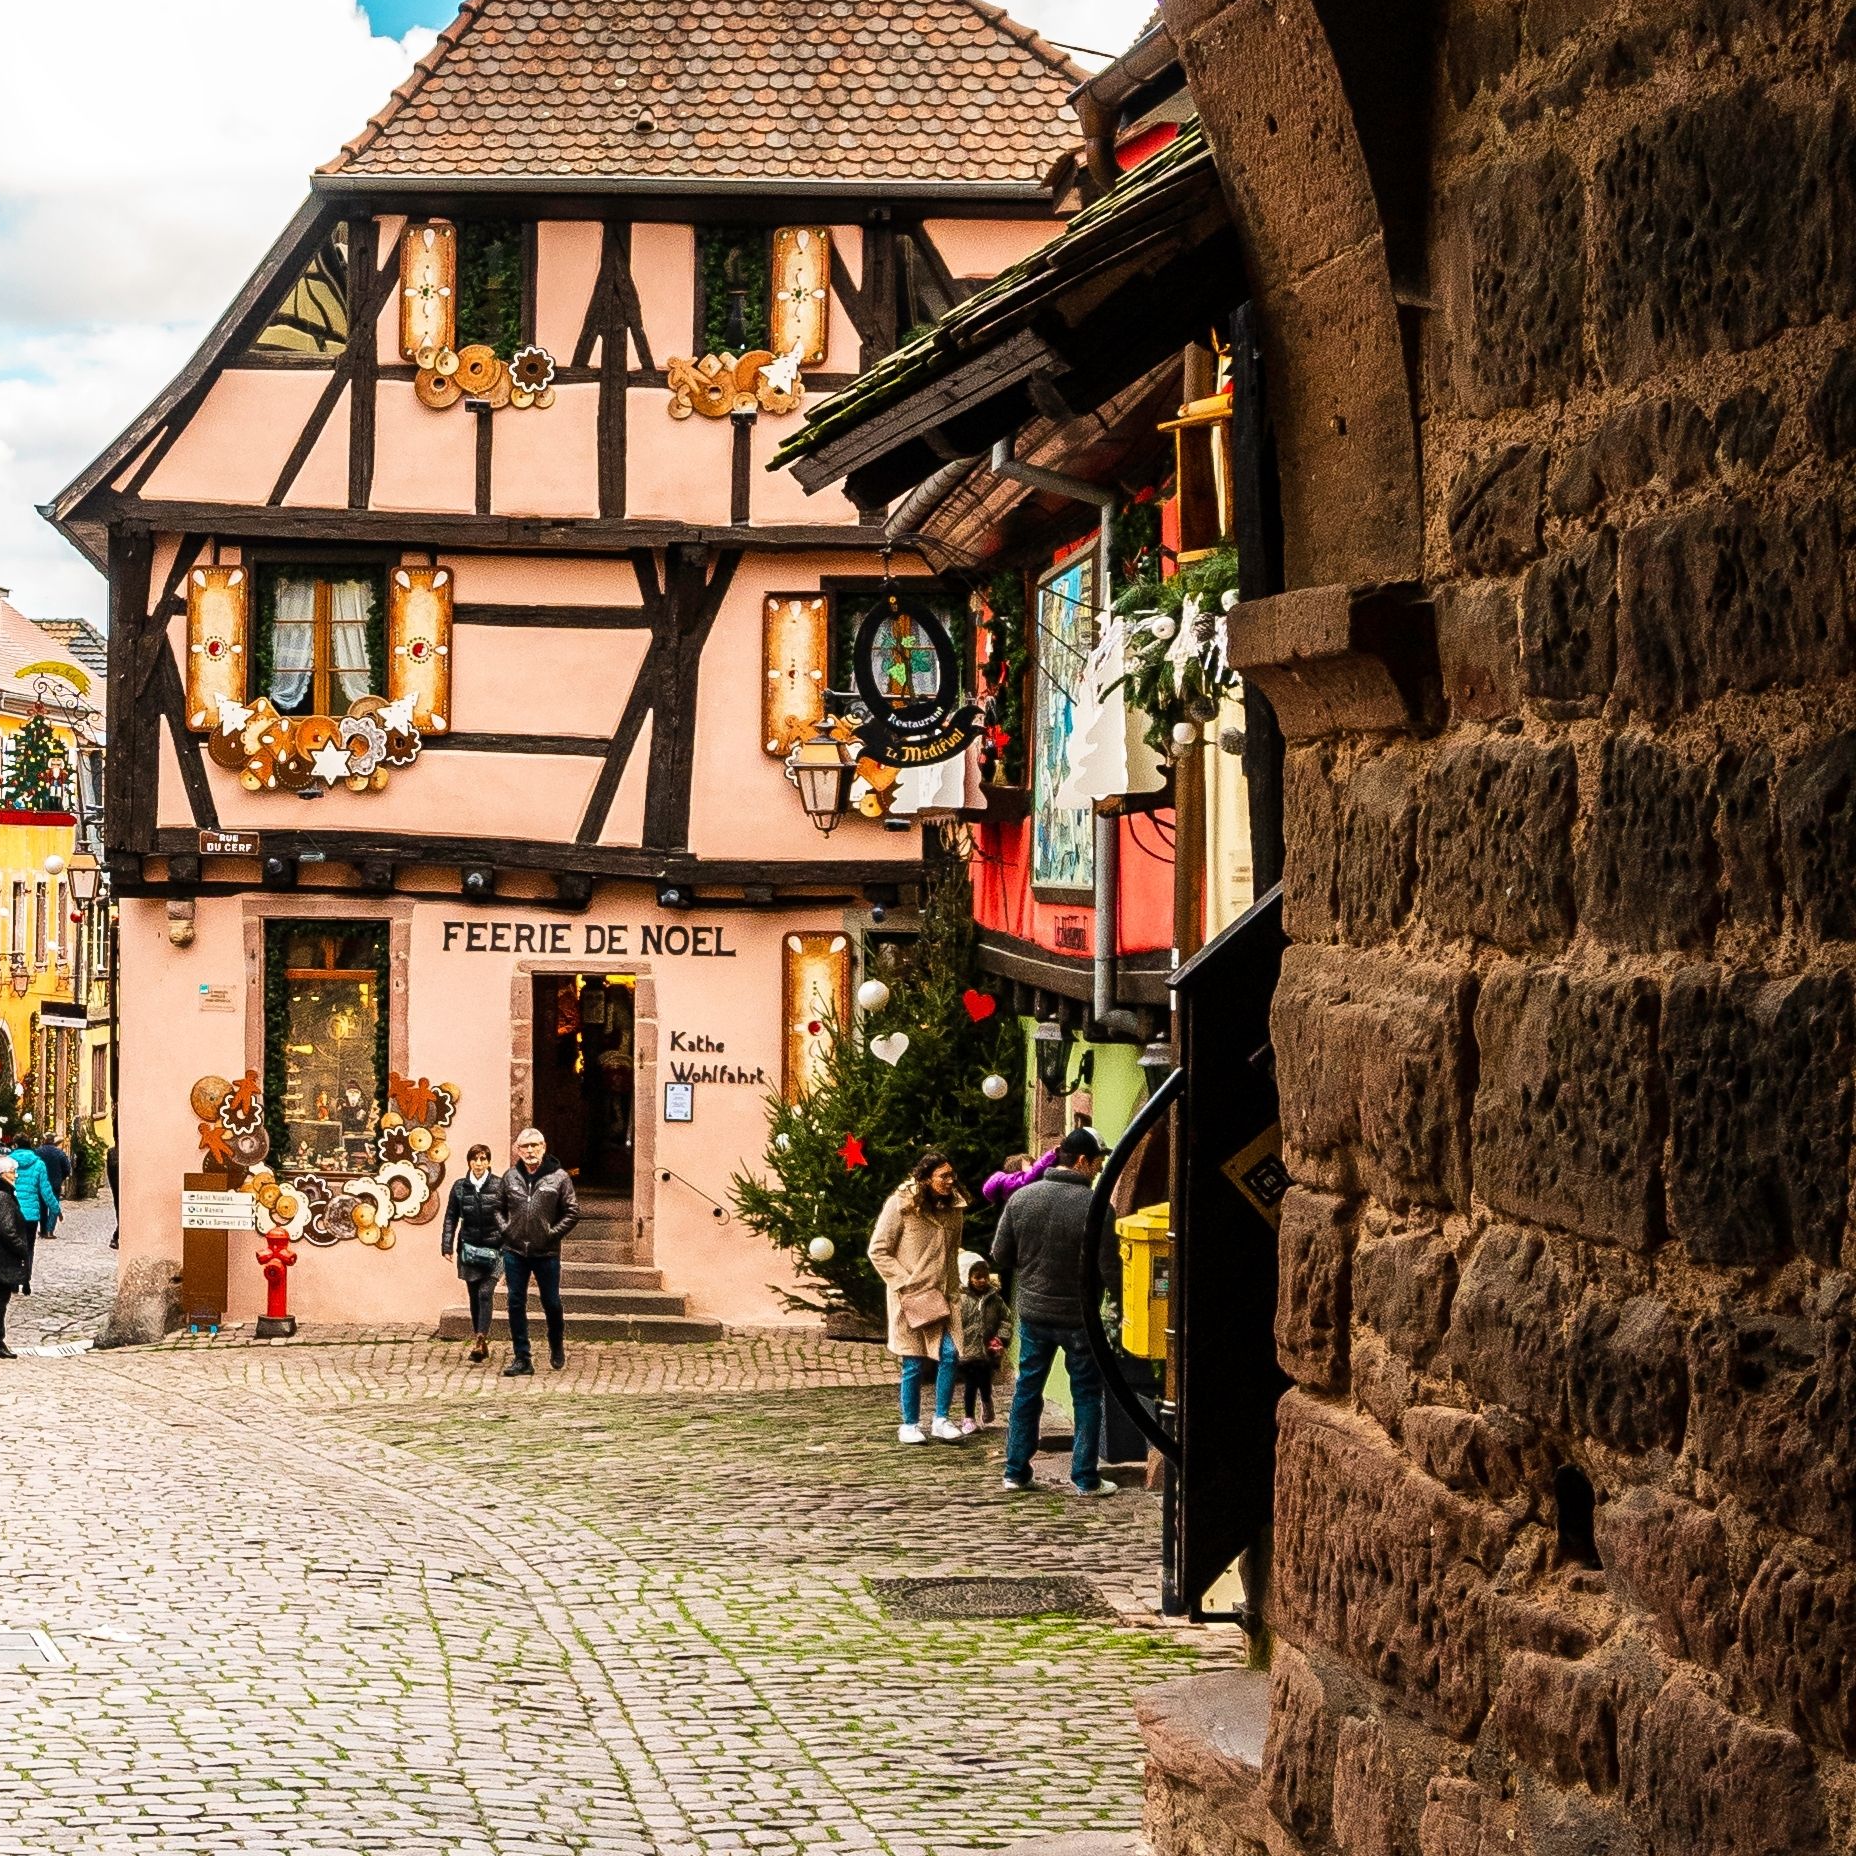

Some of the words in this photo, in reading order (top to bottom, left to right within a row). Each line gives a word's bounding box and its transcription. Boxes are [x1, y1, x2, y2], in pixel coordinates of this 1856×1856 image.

[887, 706, 944, 729] Restaurant
[885, 746, 898, 760] Le
[206, 842, 221, 852] DU
[224, 843, 252, 852] CERF
[219, 833, 239, 842] RUE
[442, 921, 572, 954] FEERIE
[584, 924, 629, 955] DE
[640, 924, 737, 957] NOEL
[670, 1031, 725, 1053] Kathe
[670, 1061, 765, 1084] Wohlfahrt
